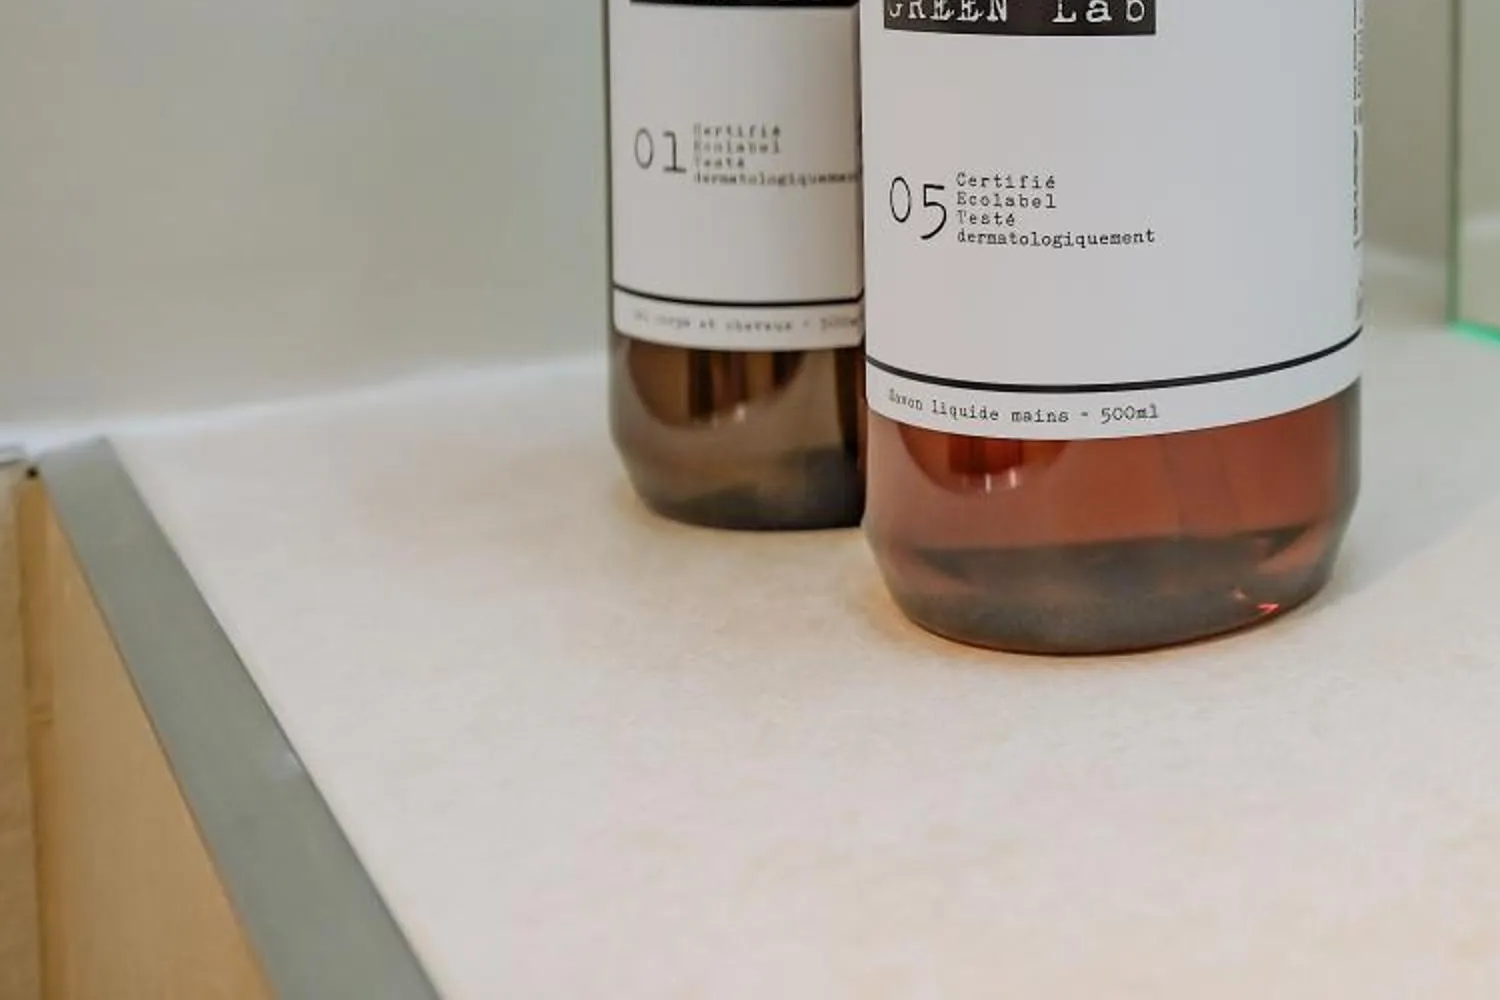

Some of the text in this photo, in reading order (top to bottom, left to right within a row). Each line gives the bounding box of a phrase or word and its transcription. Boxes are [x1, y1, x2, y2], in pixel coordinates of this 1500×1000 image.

[634, 127, 687, 174] 01
[955, 171, 1056, 189] Certifié
[889, 176, 948, 240] 05
[956, 191, 1057, 209] Ecolabel
[955, 210, 1016, 227] Testé
[956, 229, 1155, 250] dermatologiquement
[931, 400, 999, 421] liquide
[1011, 410, 1069, 423] mains
[1101, 403, 1158, 425] 500ml
